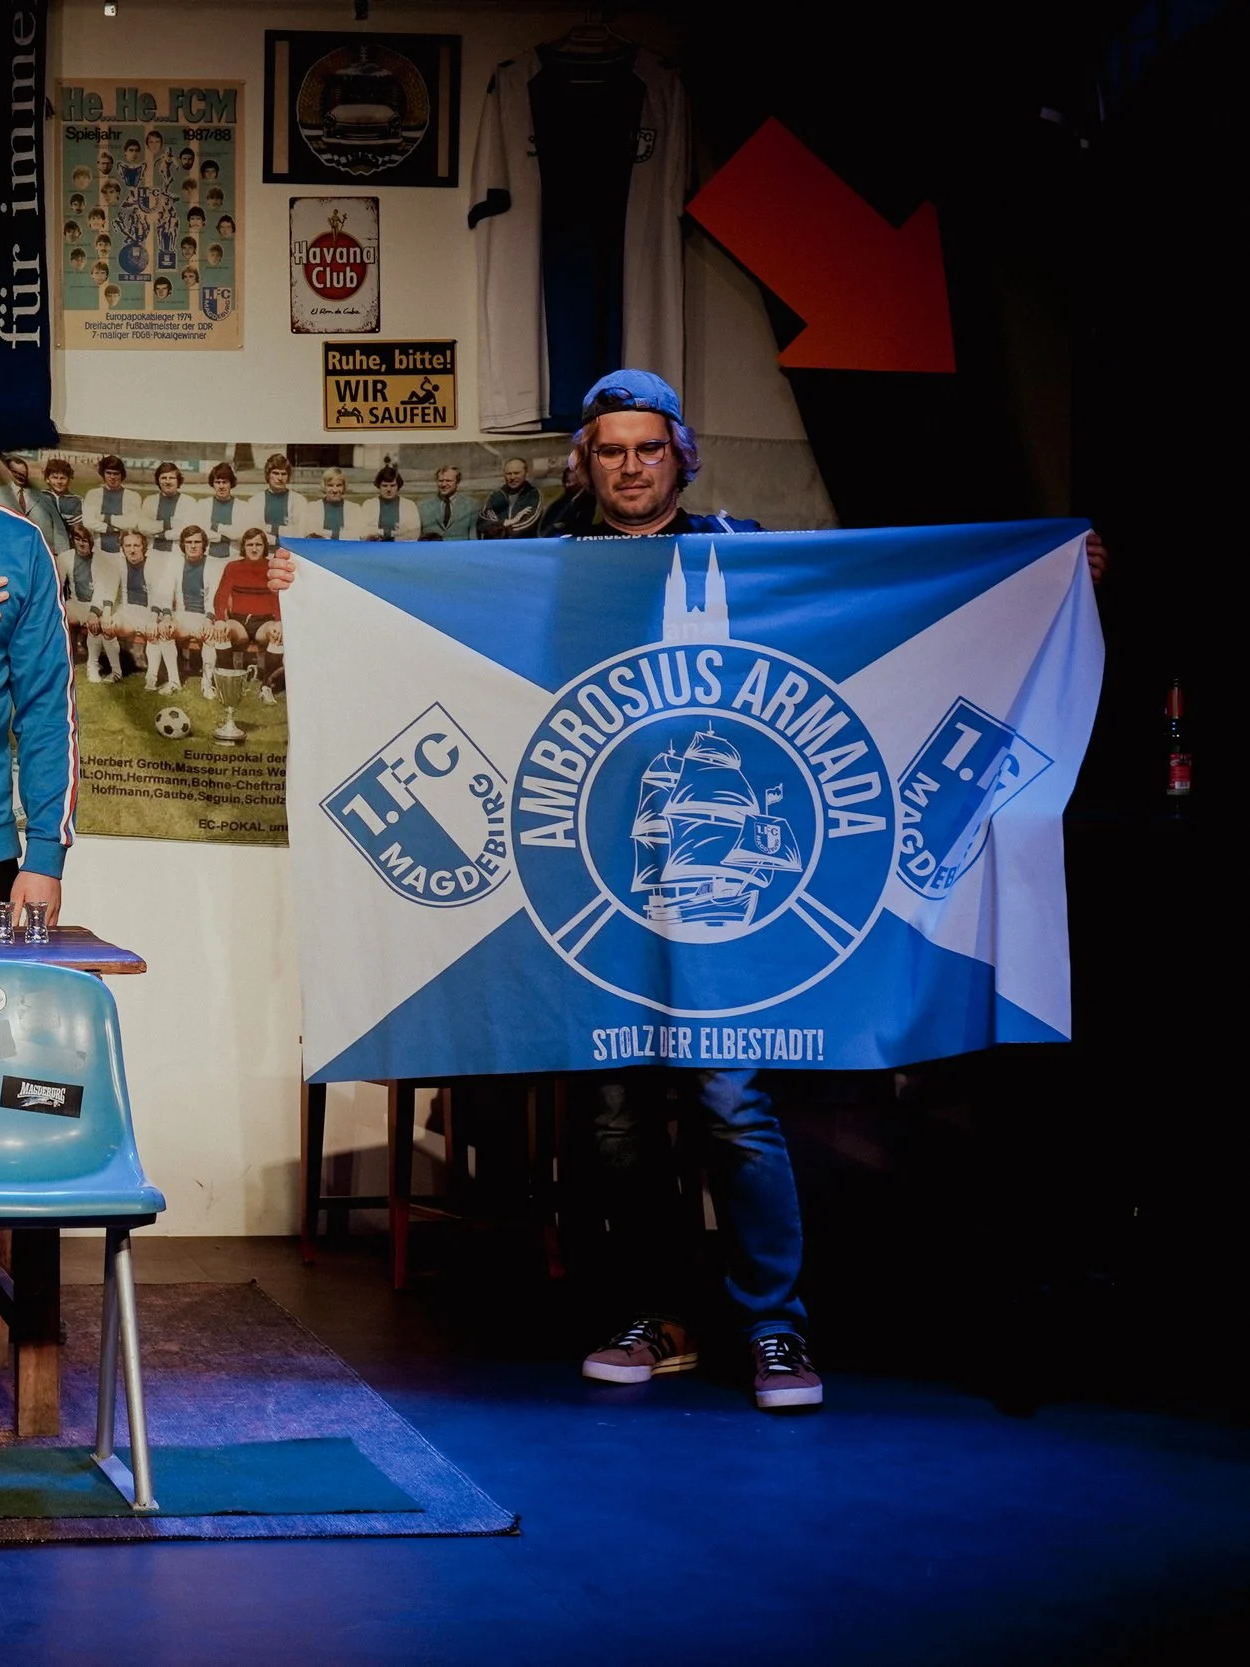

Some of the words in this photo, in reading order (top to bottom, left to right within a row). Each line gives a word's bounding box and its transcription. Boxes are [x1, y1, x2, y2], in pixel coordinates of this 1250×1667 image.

[0, 10, 39, 217] imme
[65, 126, 122, 143] Spieljahr
[294, 240, 376, 265] Havana
[311, 266, 358, 288] Club
[84, 322, 123, 330] Dreifacher
[125, 322, 180, 330] Fußballmeister
[181, 322, 195, 330] der
[198, 322, 213, 330] DDR
[105, 313, 175, 322] Europapokalsieger
[177, 313, 192, 321] 1974
[328, 349, 387, 372] Ruhe,
[394, 348, 452, 369] bitte!
[334, 379, 388, 402] WIR
[369, 406, 446, 424] SAUFEN
[184, 750, 263, 764] Europapokal
[266, 753, 287, 763] der
[519, 649, 724, 849] AMBROSIUS
[731, 657, 887, 839] ARMADA
[232, 767, 263, 777] Hans
[267, 767, 287, 777] We
[92, 783, 286, 805] Hoffmann,Gaube,Seguin,Schulz
[199, 819, 265, 831] EC-POKAL
[902, 771, 960, 890] MAGDEB
[592, 1025, 656, 1060] STOLZ
[660, 1026, 693, 1059] DER
[700, 1026, 824, 1061] ELBESTADT!
[17, 1081, 67, 1105] MAGDEBURG
